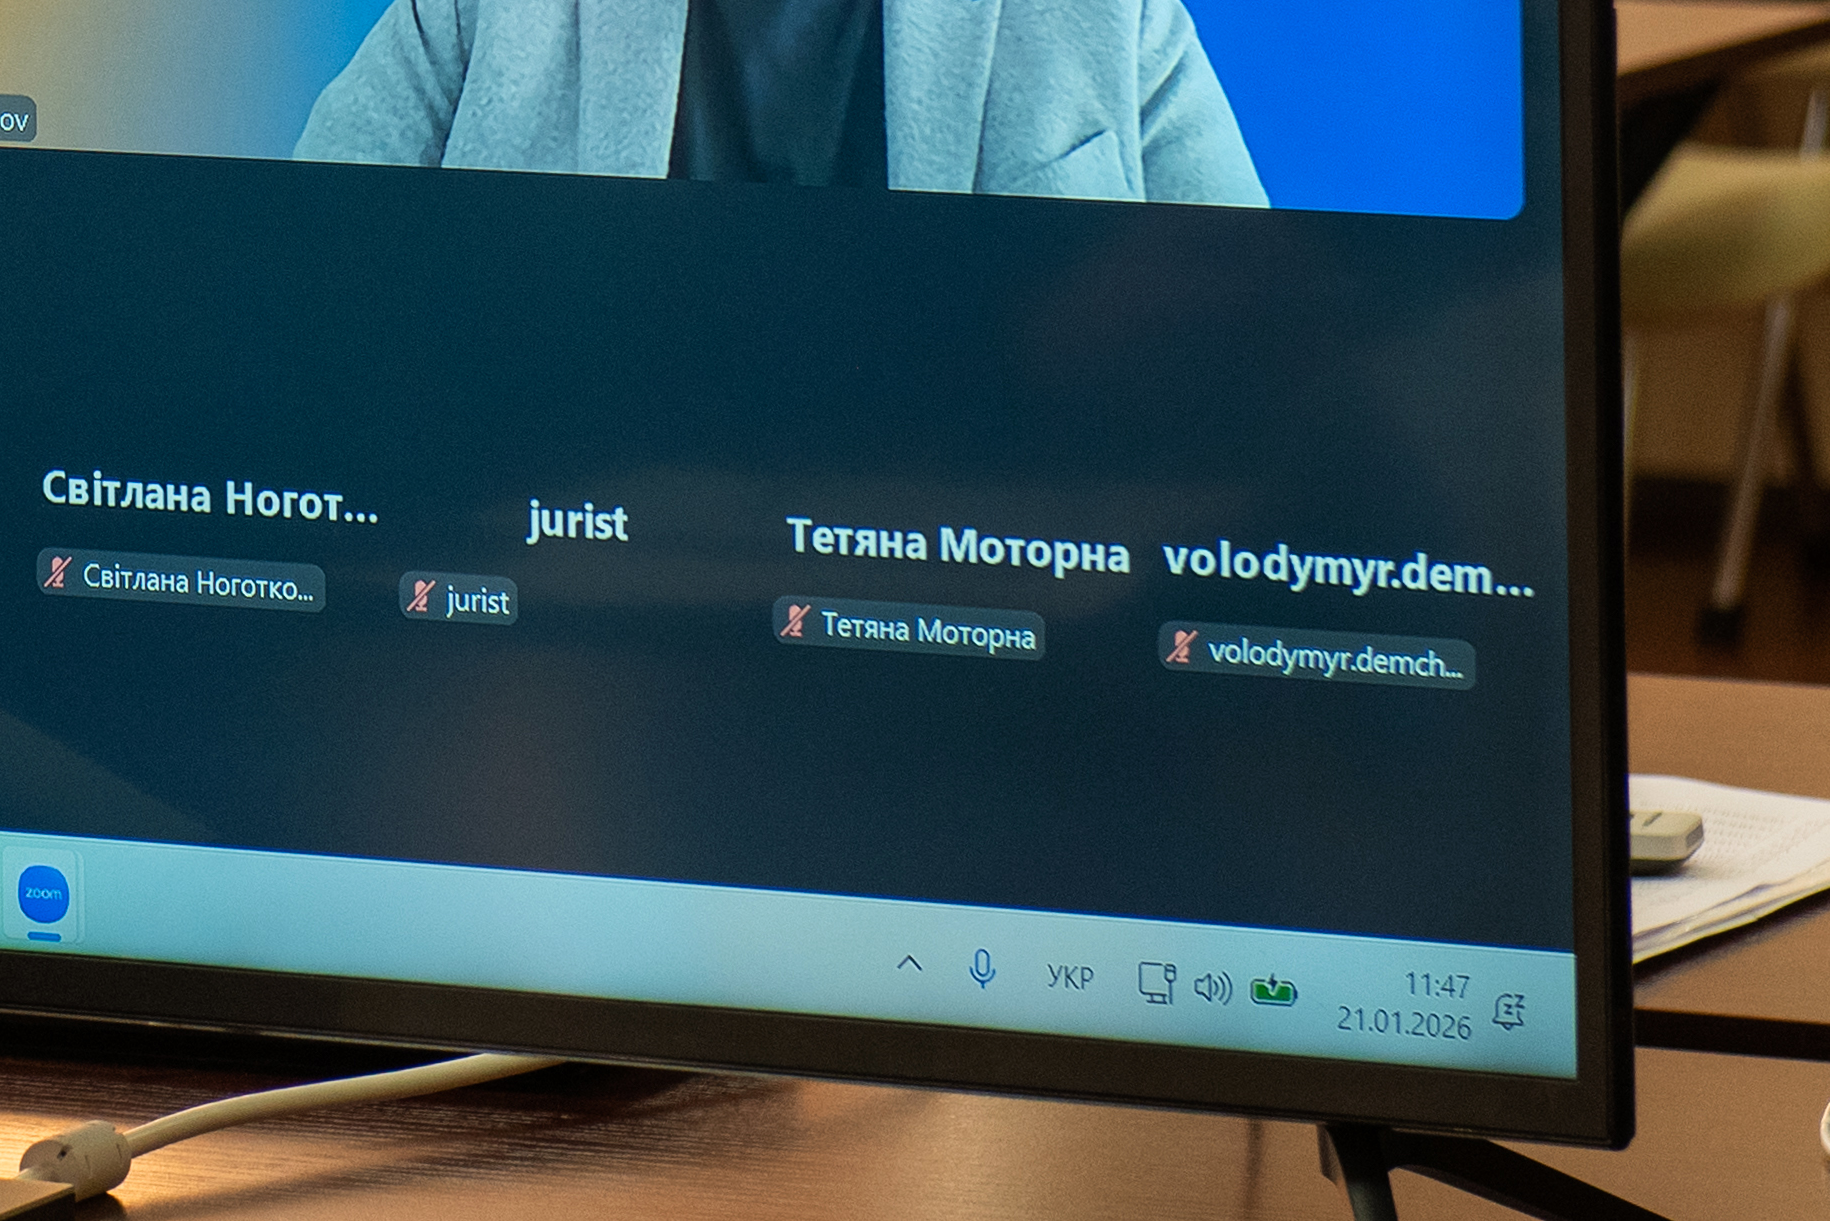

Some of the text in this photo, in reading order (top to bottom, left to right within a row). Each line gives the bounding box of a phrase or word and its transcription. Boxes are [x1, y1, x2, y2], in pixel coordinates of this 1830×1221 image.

[43, 470, 377, 523] Світлана Ногот...
[526, 499, 628, 544] jurist
[787, 518, 1130, 578] Тетяна Моторна
[1164, 540, 1534, 596] volodymyr.dem...
[84, 563, 313, 601] Світлана Ноготко...
[447, 585, 510, 618] jurist
[822, 611, 1036, 654] Тетяна Моторна
[1209, 637, 1464, 679] volodymyr.demch...
[25, 887, 63, 901] zoom
[1048, 964, 1094, 989] УКР
[1407, 972, 1470, 998] 11:47
[1338, 1006, 1472, 1040] 21.01.2026
